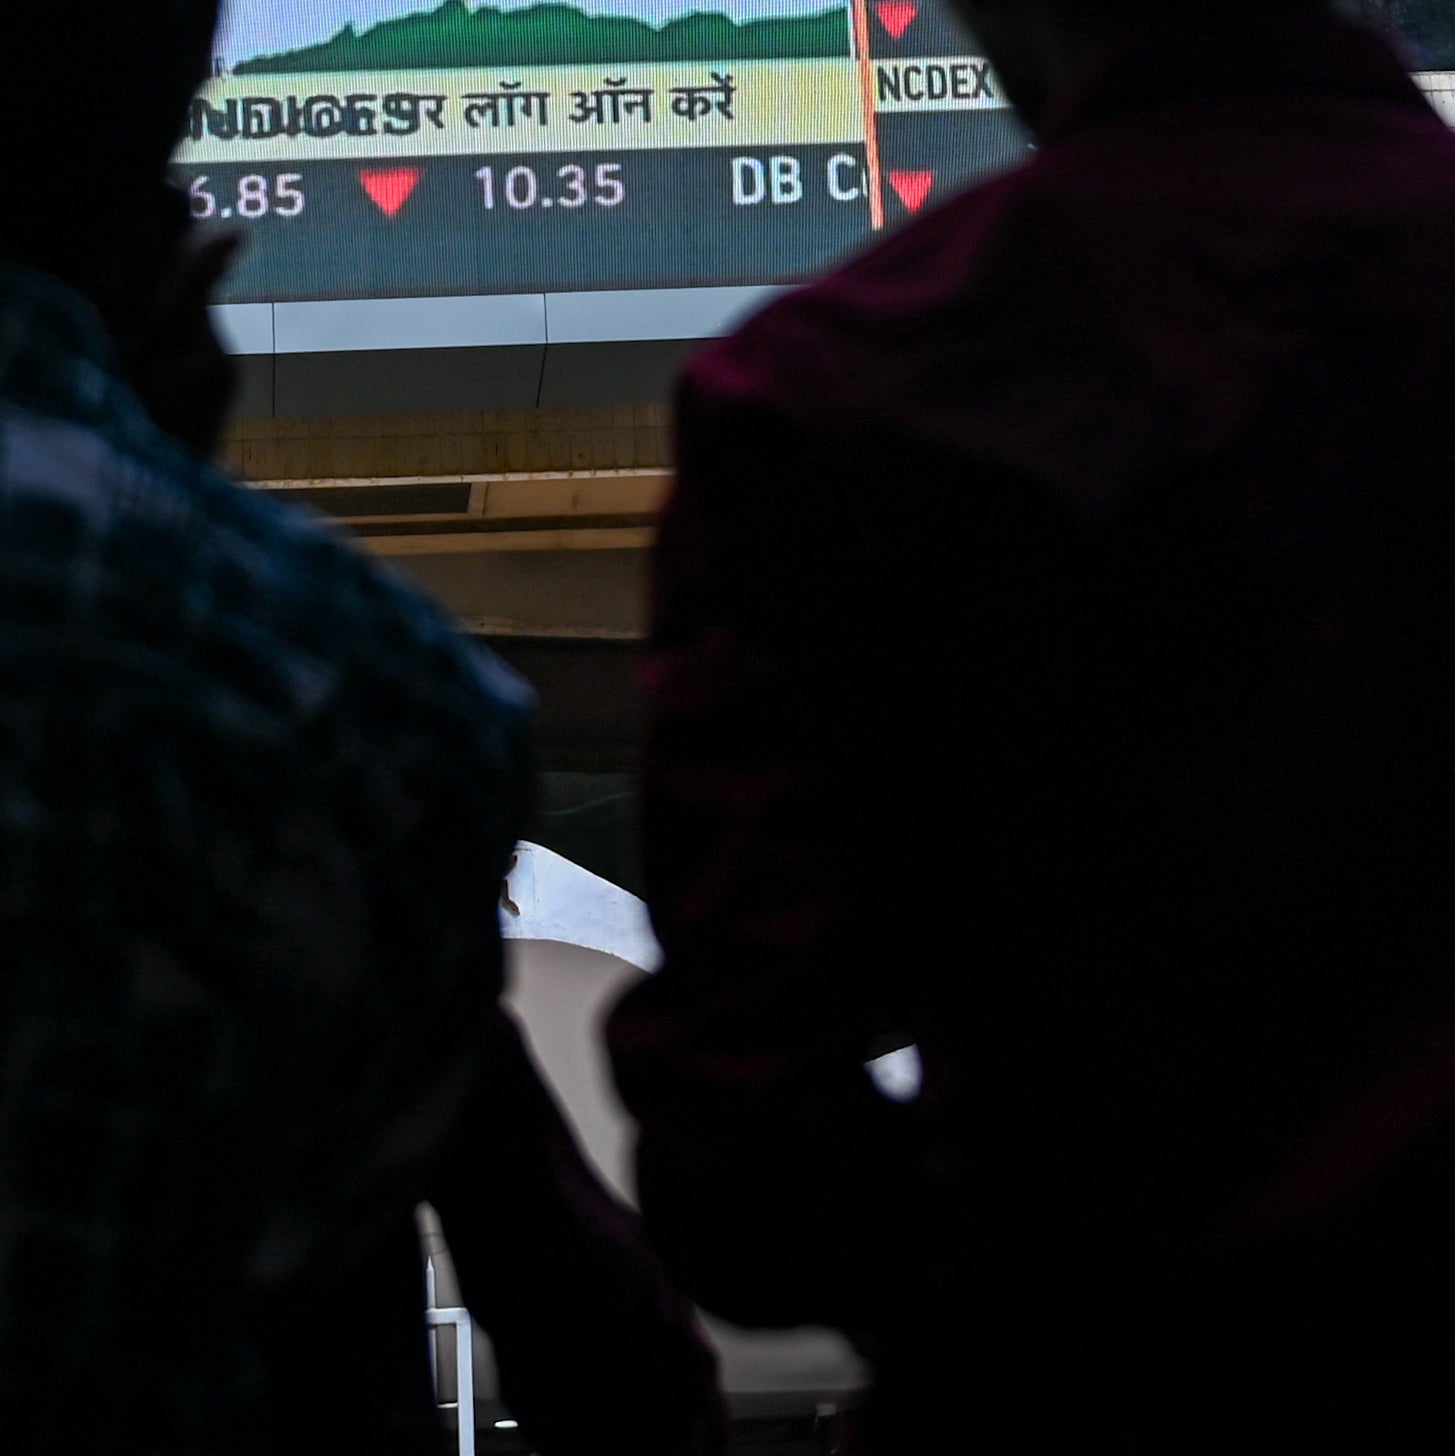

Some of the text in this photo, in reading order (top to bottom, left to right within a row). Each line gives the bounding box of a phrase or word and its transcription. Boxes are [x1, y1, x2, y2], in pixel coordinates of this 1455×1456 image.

[461, 80, 551, 127] लॉग
[568, 76, 655, 124] ऑन
[877, 62, 993, 103] NCDEX
[475, 164, 626, 210] 10.35
[732, 151, 869, 206] DB C
